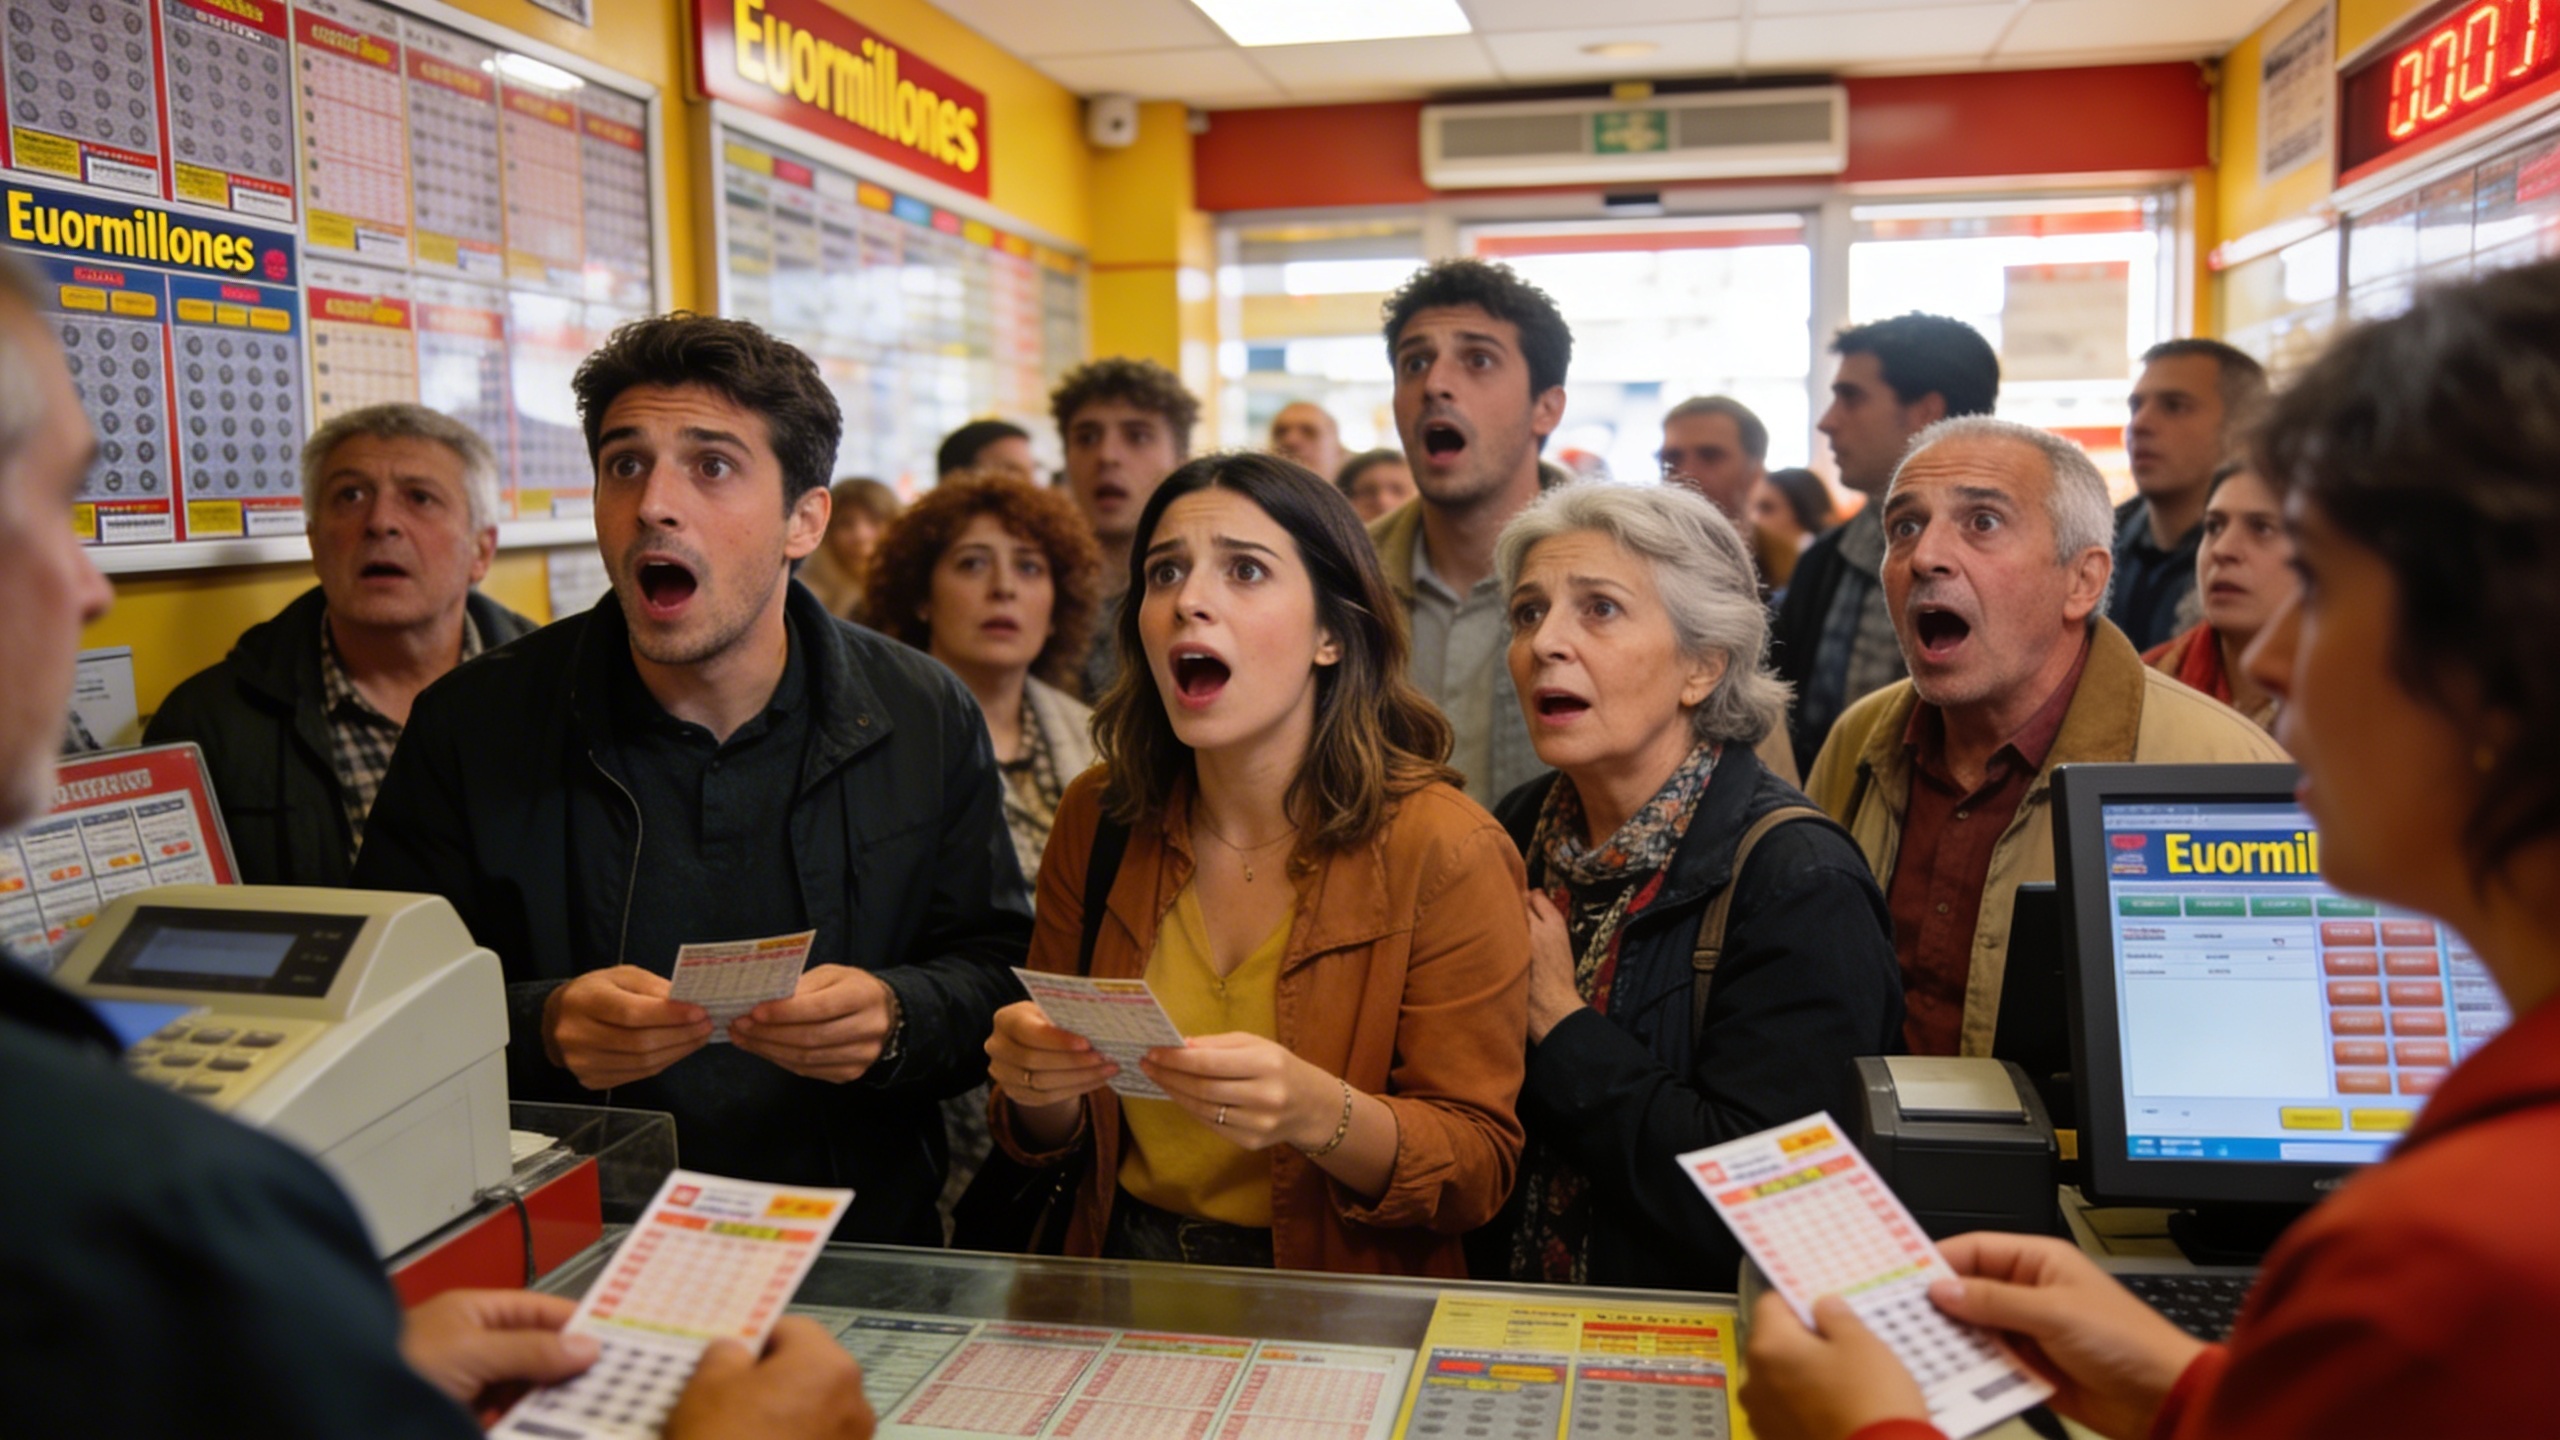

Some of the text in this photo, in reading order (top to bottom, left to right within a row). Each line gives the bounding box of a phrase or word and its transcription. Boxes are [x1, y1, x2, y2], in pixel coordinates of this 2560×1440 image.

[734, 0, 980, 173] Euormillones
[7, 189, 255, 272] Euormillones
[2165, 831, 2319, 874] Euormil
